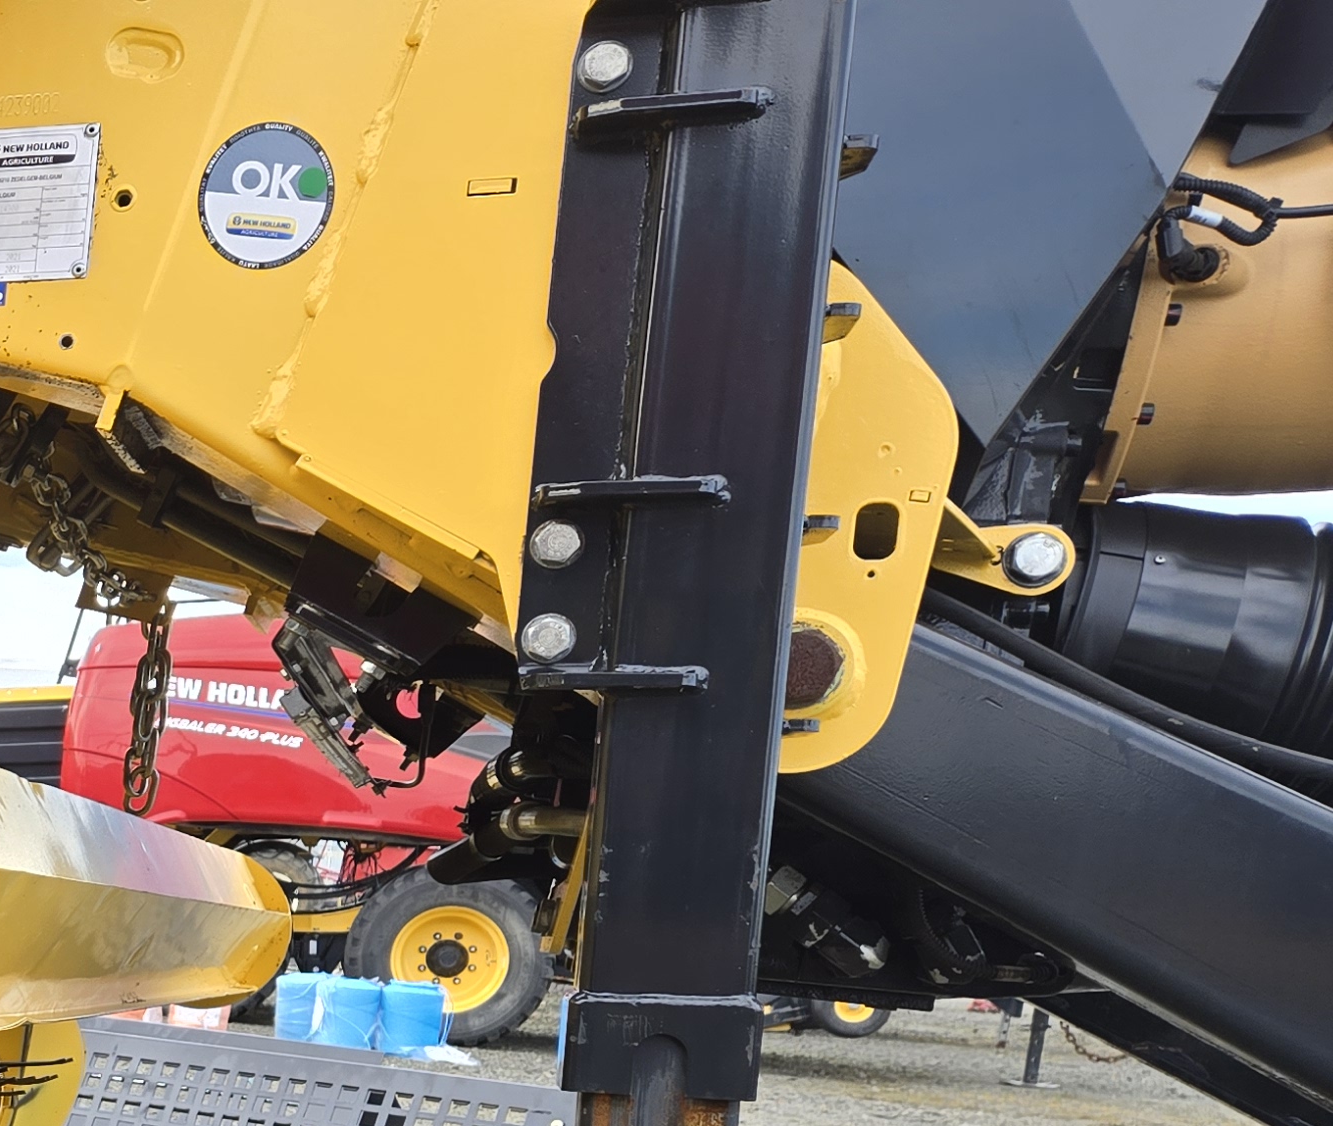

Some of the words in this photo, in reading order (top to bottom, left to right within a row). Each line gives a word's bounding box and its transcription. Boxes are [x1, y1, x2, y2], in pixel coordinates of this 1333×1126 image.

[264, 123, 293, 132] QUALITY
[3, 144, 24, 153] NEW
[26, 141, 70, 152] HOLLAND
[2, 156, 54, 166] AGRICULTURE
[232, 160, 302, 201] OK
[243, 218, 259, 226] NEW
[260, 220, 291, 229] HOLLAND
[165, 675, 202, 700] EW
[207, 681, 285, 710] HOLLA
